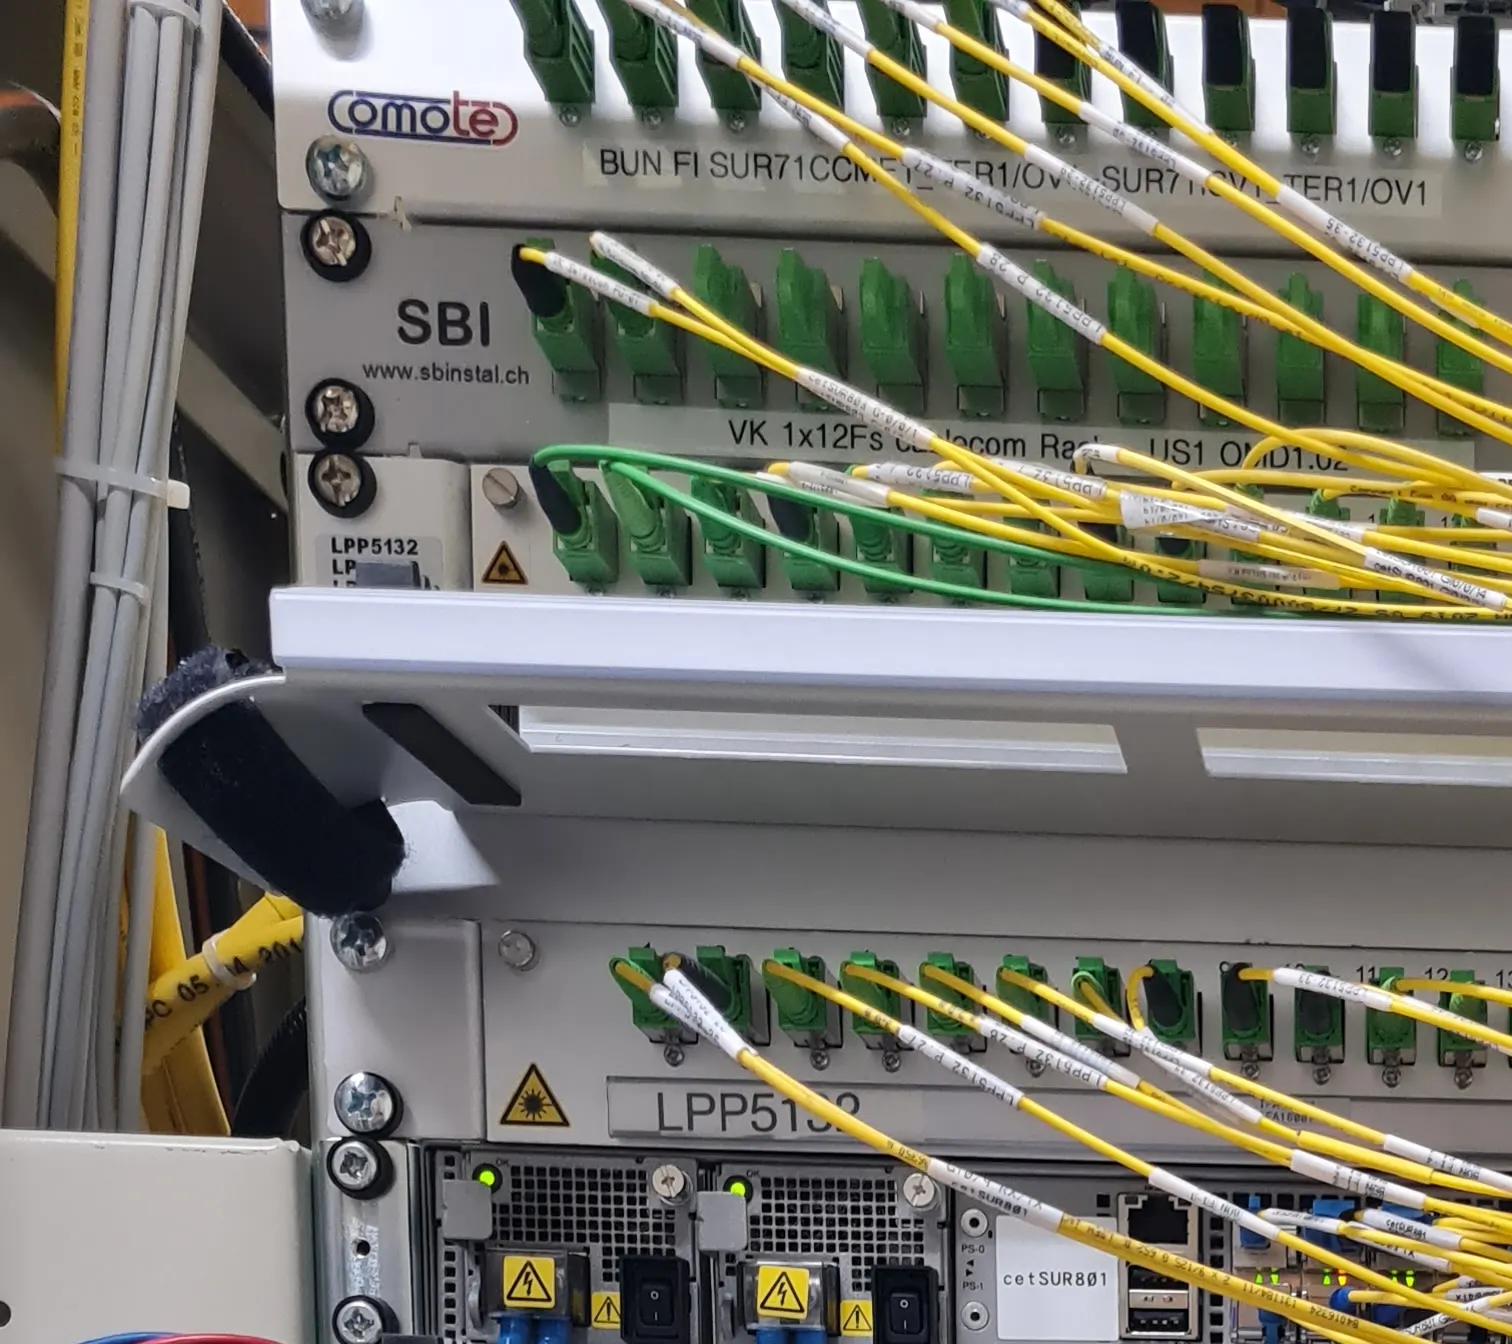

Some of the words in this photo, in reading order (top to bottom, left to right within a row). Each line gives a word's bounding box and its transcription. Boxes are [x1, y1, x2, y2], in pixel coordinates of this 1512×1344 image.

[600, 149, 661, 176] BUN
[674, 150, 698, 178] FI
[1323, 216, 1405, 272] LPP5132-35
[397, 299, 491, 348] SBI
[362, 361, 530, 386] www.sbinstal.ch
[729, 419, 768, 446] VK
[783, 423, 883, 450] 1x12Fs
[331, 537, 418, 555] LPP5132
[1031, 1047, 1102, 1087] LPP5132
[961, 1244, 984, 1253] PS-0
[963, 1281, 983, 1290] PS-1
[1004, 1272, 1105, 1286] cetSUR801
